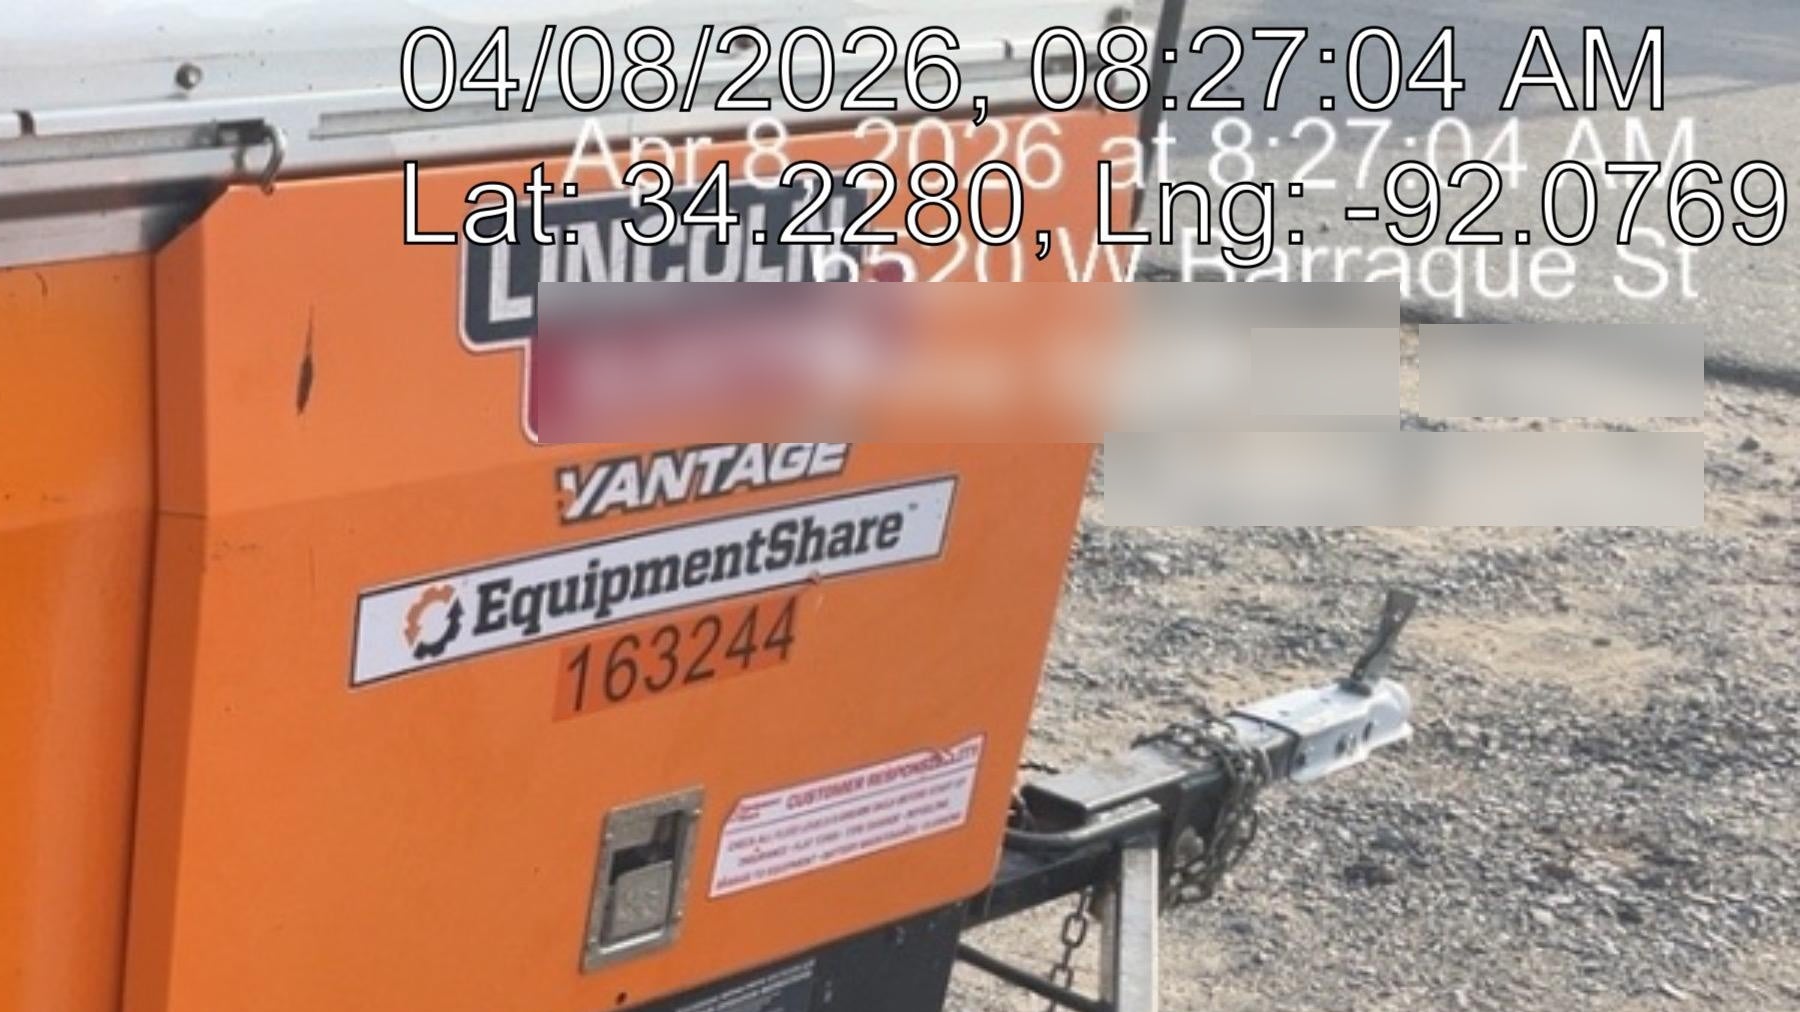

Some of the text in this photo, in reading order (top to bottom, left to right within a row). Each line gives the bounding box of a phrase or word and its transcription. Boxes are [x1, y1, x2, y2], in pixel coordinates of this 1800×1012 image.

[560, 443, 849, 520] VANTAGE
[473, 511, 903, 634] EquipmentShare
[567, 595, 798, 712] 163244
